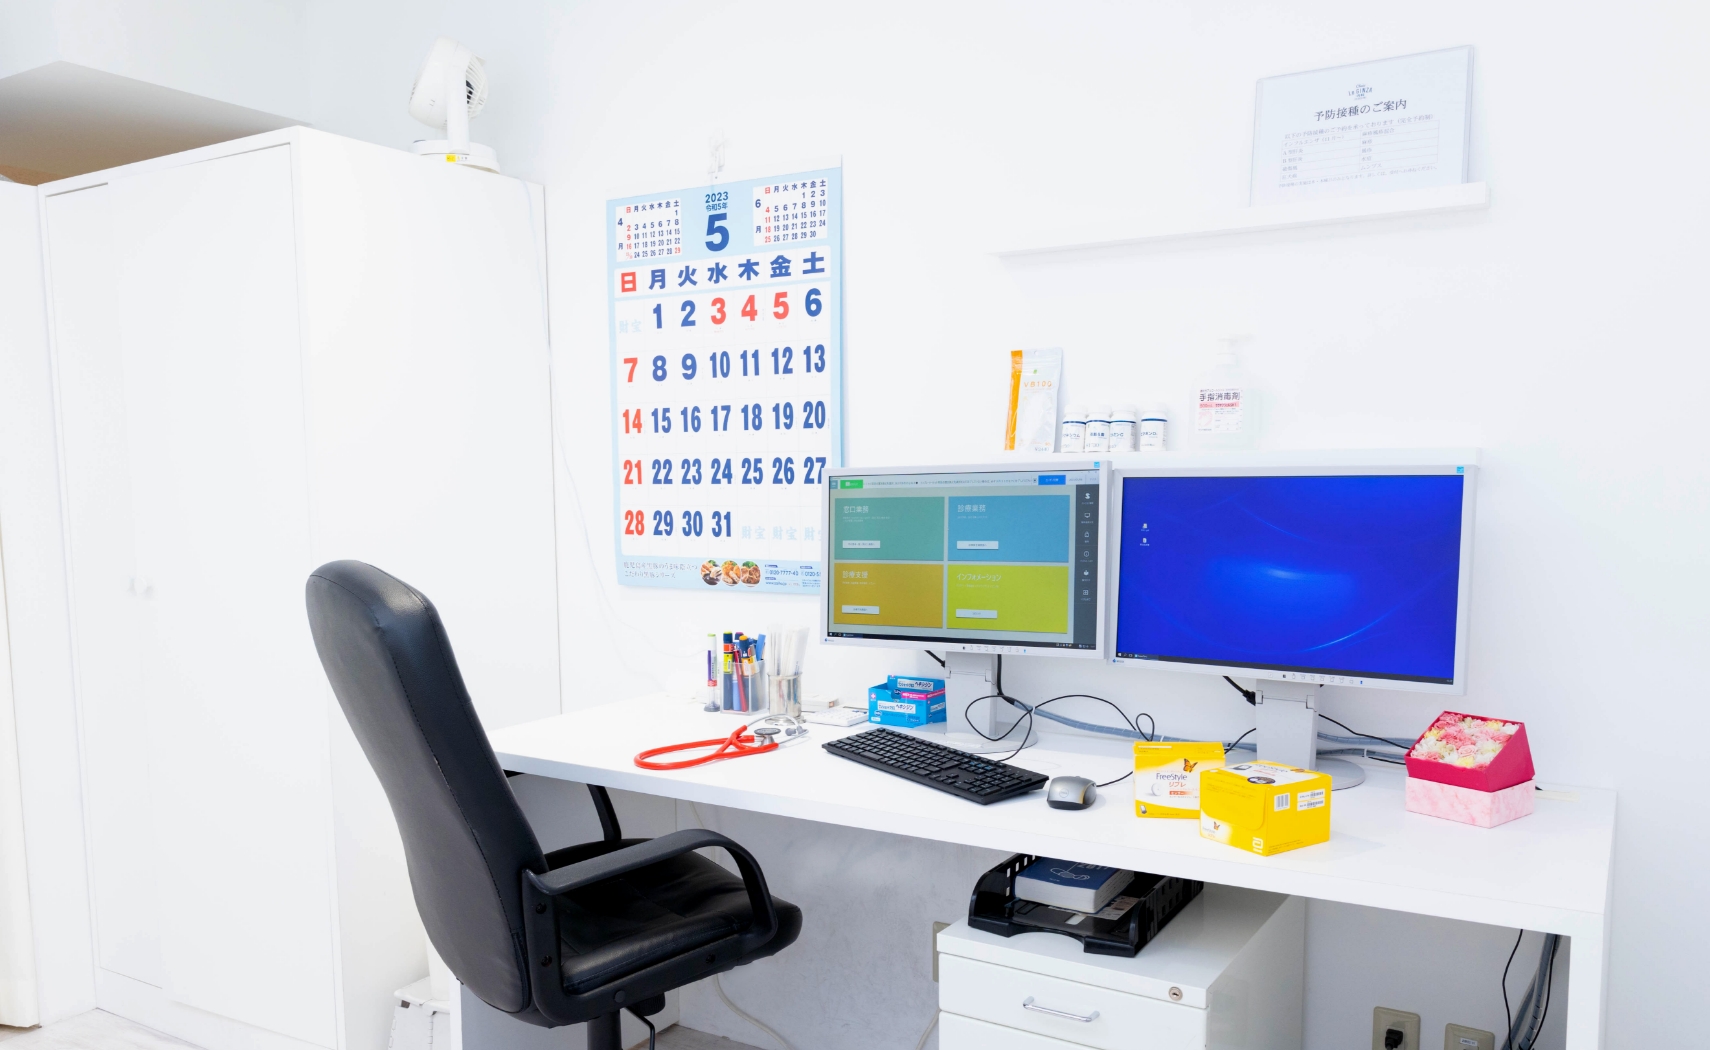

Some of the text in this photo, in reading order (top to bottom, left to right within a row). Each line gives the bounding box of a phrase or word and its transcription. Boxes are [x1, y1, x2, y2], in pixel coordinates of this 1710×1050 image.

[1314, 99, 1407, 122] 予防接種のご案内
[783, 184, 789, 192] 火
[792, 183, 798, 191] 水
[820, 179, 826, 187] 土
[705, 191, 729, 203] 2023
[706, 202, 728, 212] 令和5年
[755, 199, 761, 208] 6
[618, 218, 623, 226] 4
[819, 219, 825, 227] 24
[705, 212, 730, 252] 5
[621, 251, 825, 292] 日 月 火 水 木 金 土
[653, 303, 663, 329] 1
[681, 300, 696, 327] 2
[711, 297, 726, 325] 3
[741, 295, 757, 321] 4
[773, 291, 790, 320] 5
[805, 288, 822, 317] 6
[623, 344, 826, 383] 7 8 9 10 11 12 13
[1199, 391, 1241, 402] 手指消毒剤
[622, 400, 826, 434] 14 15 16 17 18 19 20
[624, 456, 826, 485] 21 22 23 24 25 26 27
[843, 505, 869, 514] 窓口業務
[957, 504, 986, 513] 診療業務
[624, 510, 645, 536] 28
[653, 510, 674, 537] 29
[682, 510, 703, 537] 30
[711, 510, 731, 537] 31
[842, 571, 868, 579] 診療支援
[956, 573, 1002, 582] インフォメーション
[1156, 773, 1187, 781] FreeStyle
